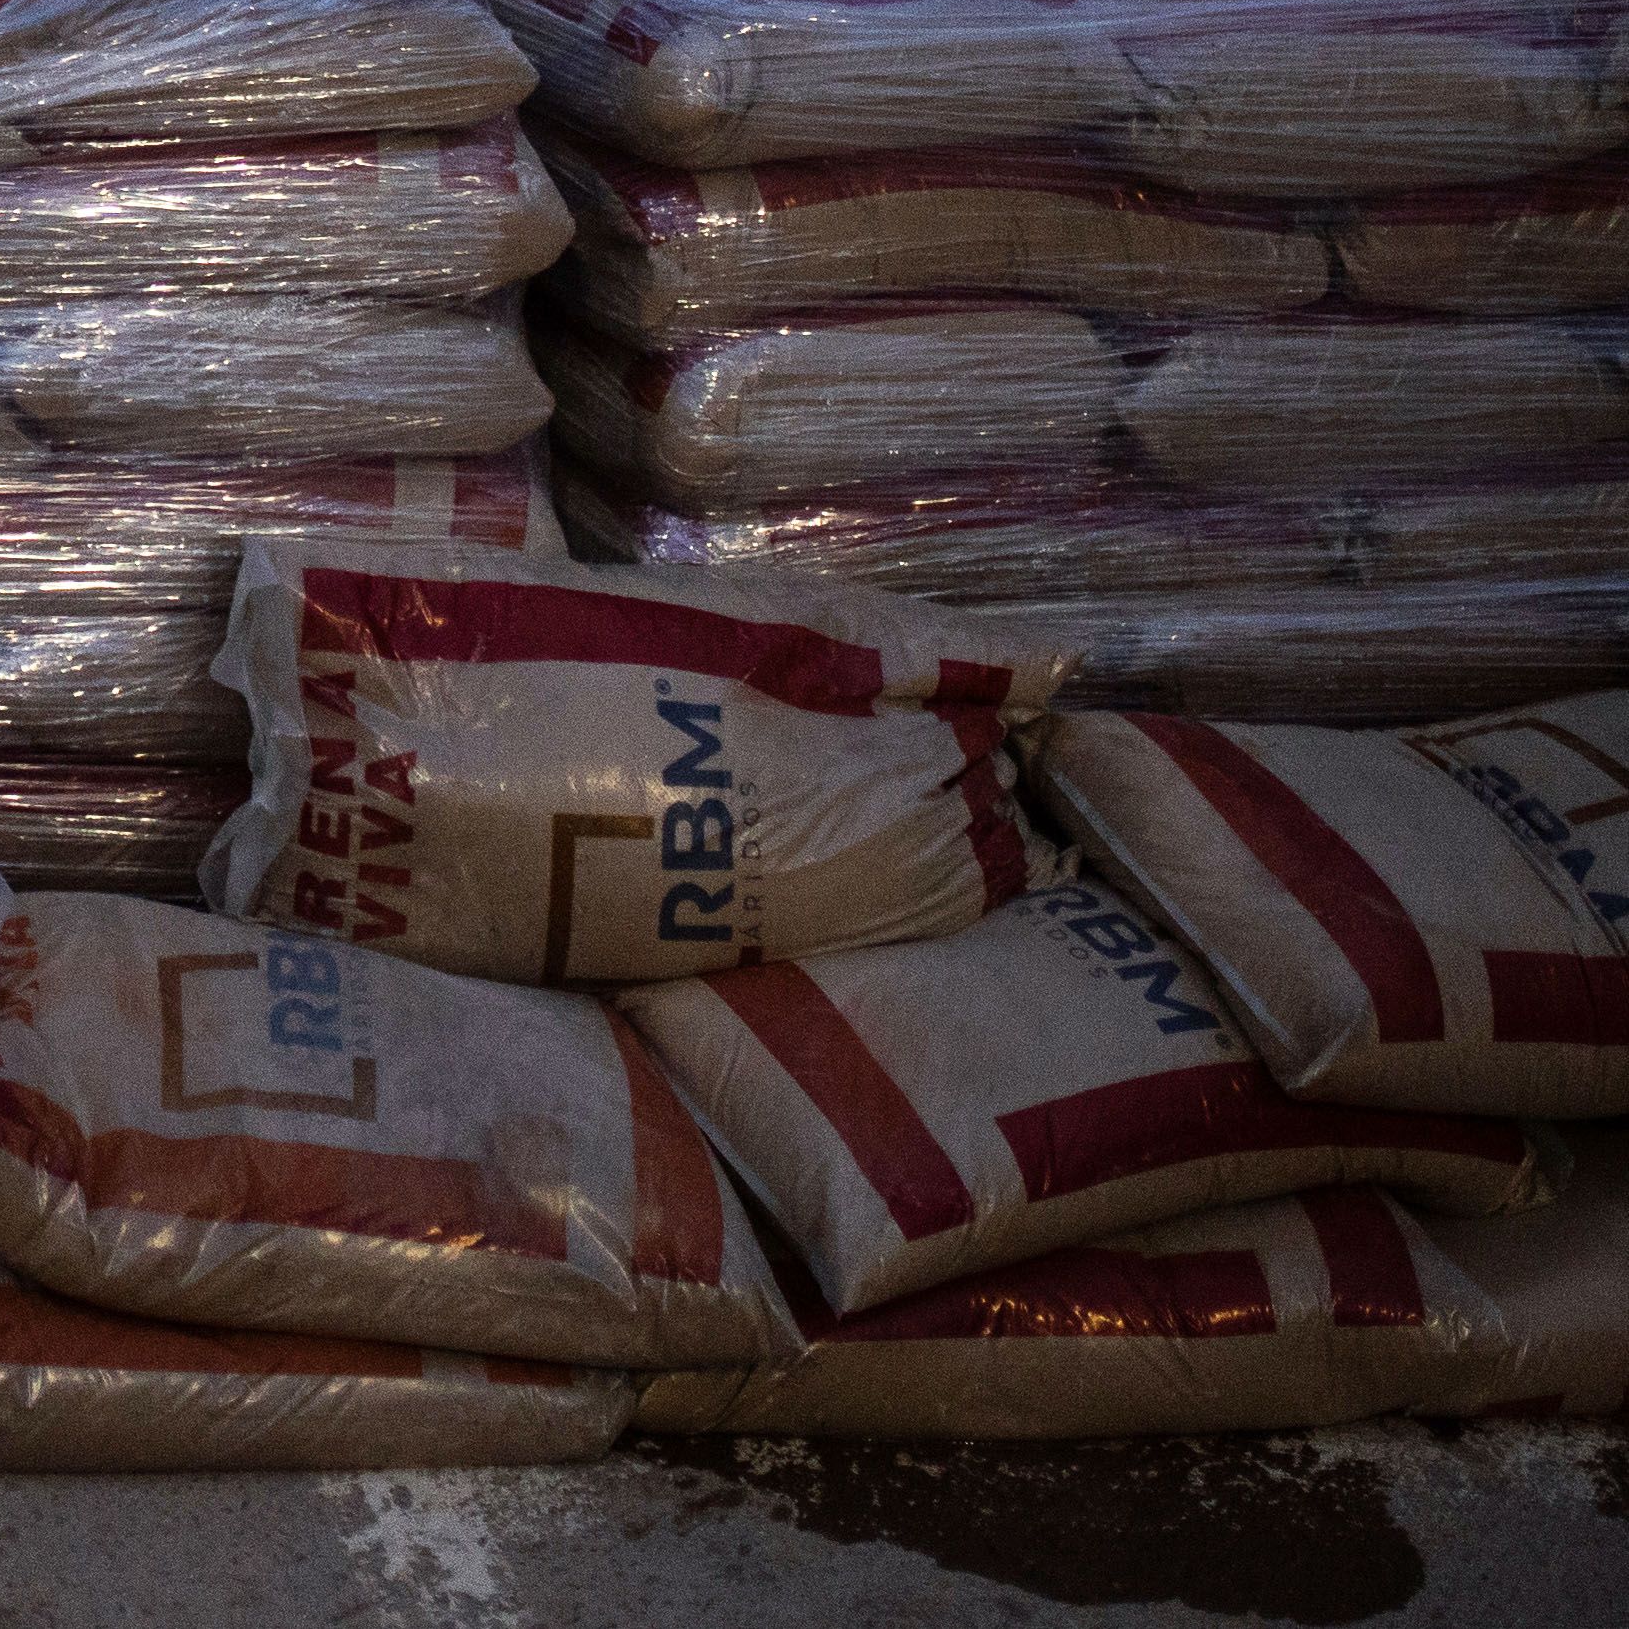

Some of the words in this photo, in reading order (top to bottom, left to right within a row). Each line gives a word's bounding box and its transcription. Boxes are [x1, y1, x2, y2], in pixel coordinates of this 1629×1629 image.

[294, 670, 356, 931] RENA
[353, 750, 417, 943] VIVA
[657, 698, 735, 943] RBM
[265, 930, 345, 1053] RB
[1018, 885, 1221, 1035] RBM
